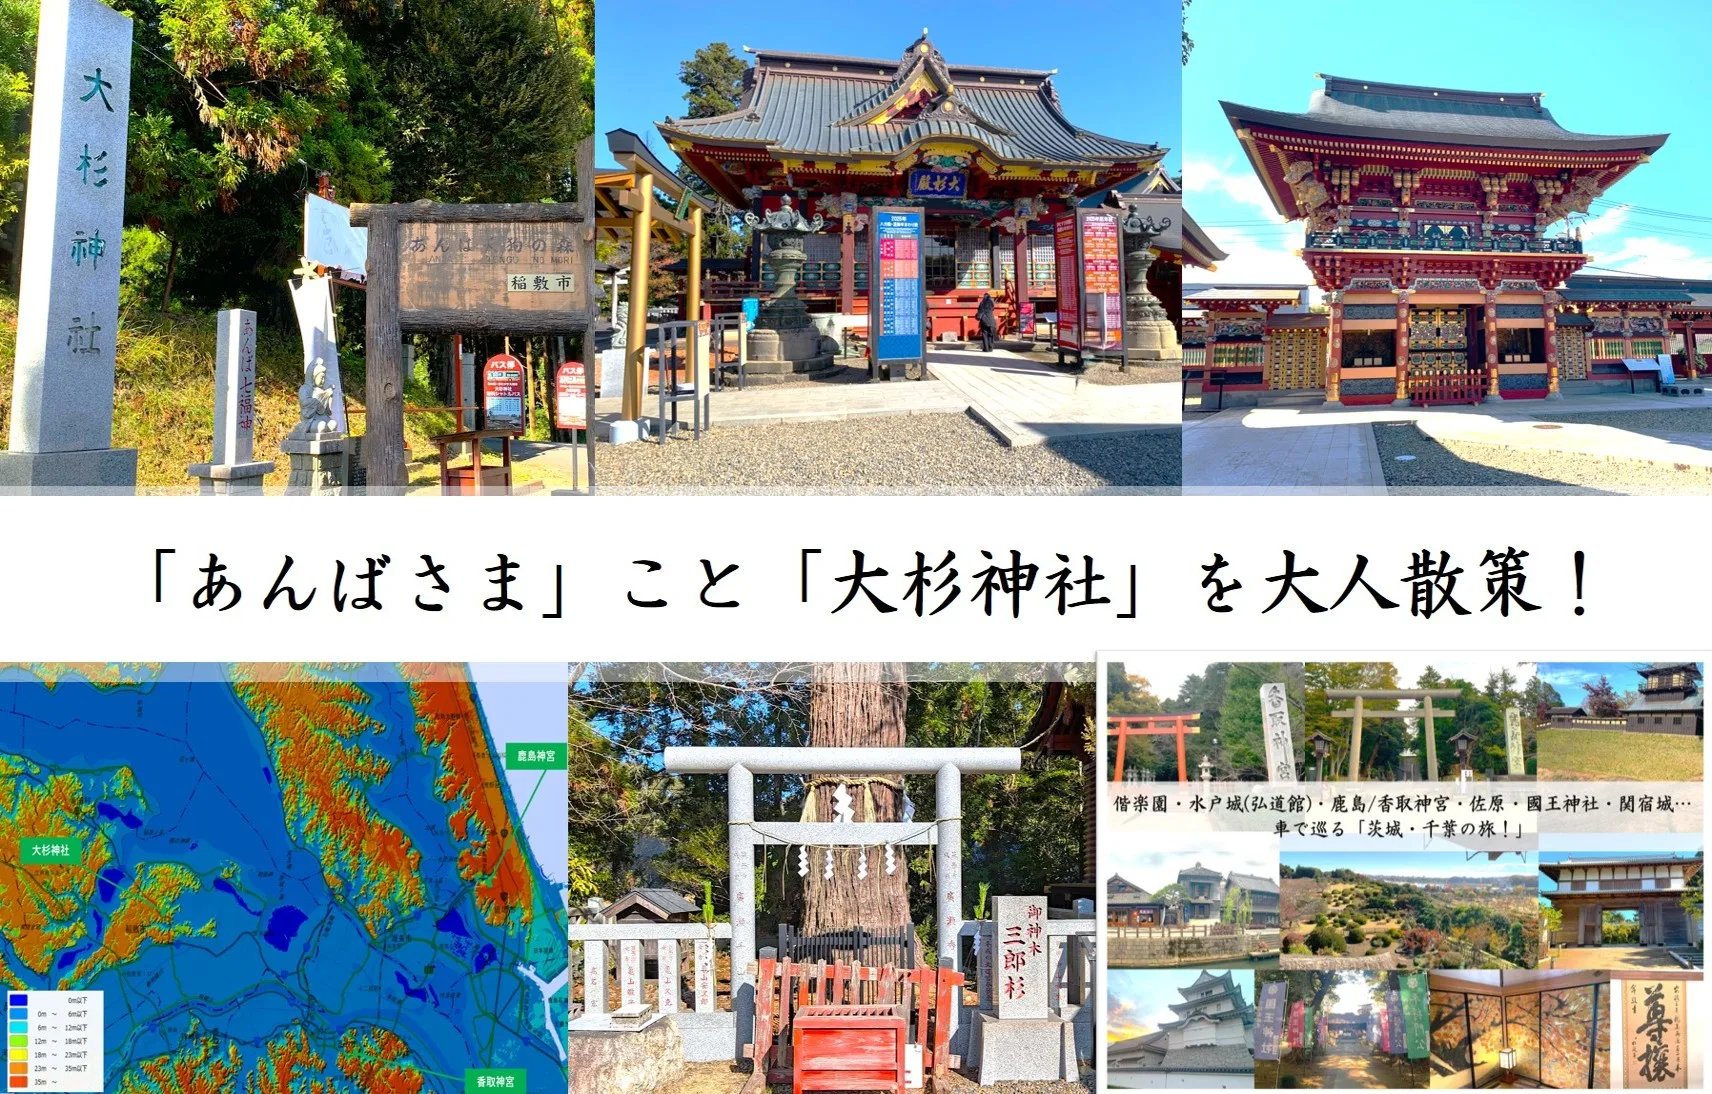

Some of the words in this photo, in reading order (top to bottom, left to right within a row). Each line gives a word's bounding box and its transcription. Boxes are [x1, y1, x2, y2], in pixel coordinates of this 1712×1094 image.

[66, 67, 114, 354] 大杉神社
[511, 275, 572, 291] 稲敷市
[551, 256, 574, 265] MORI
[239, 318, 255, 432] あんば七福神
[490, 360, 516, 370] バス停
[1267, 684, 1292, 781] 香取神宮
[1026, 904, 1043, 957] 御神木
[1002, 926, 1026, 1000] 三郎杉
